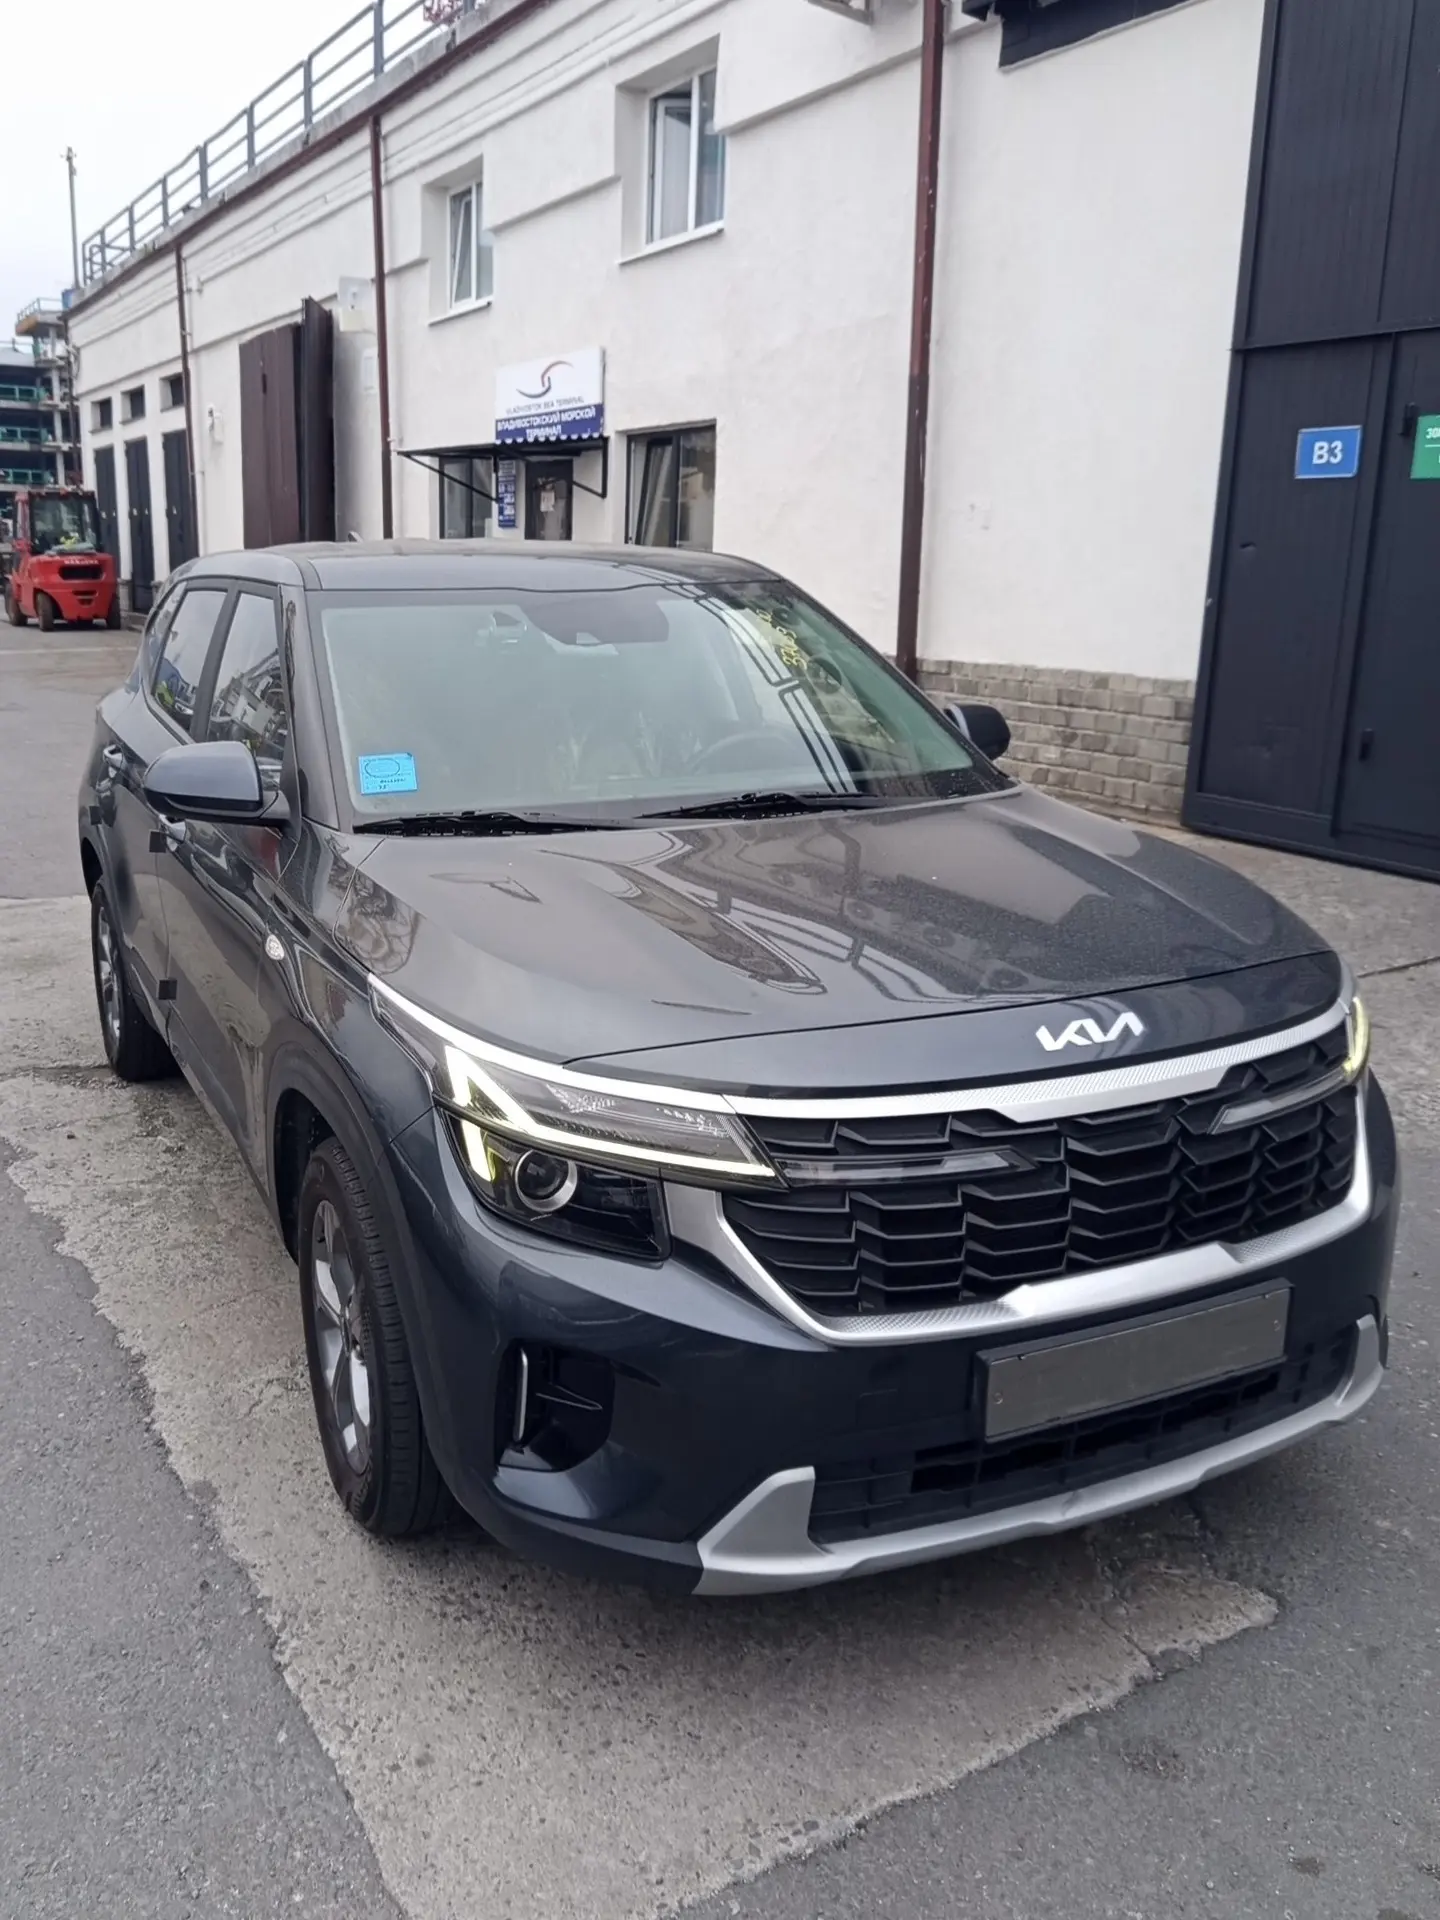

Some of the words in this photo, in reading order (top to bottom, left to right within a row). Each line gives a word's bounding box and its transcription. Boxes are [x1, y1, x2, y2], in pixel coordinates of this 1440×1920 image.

[561, 406, 595, 421] МОРСКОЙ
[1312, 440, 1343, 464] B3
[1036, 1011, 1144, 1051] KIA
